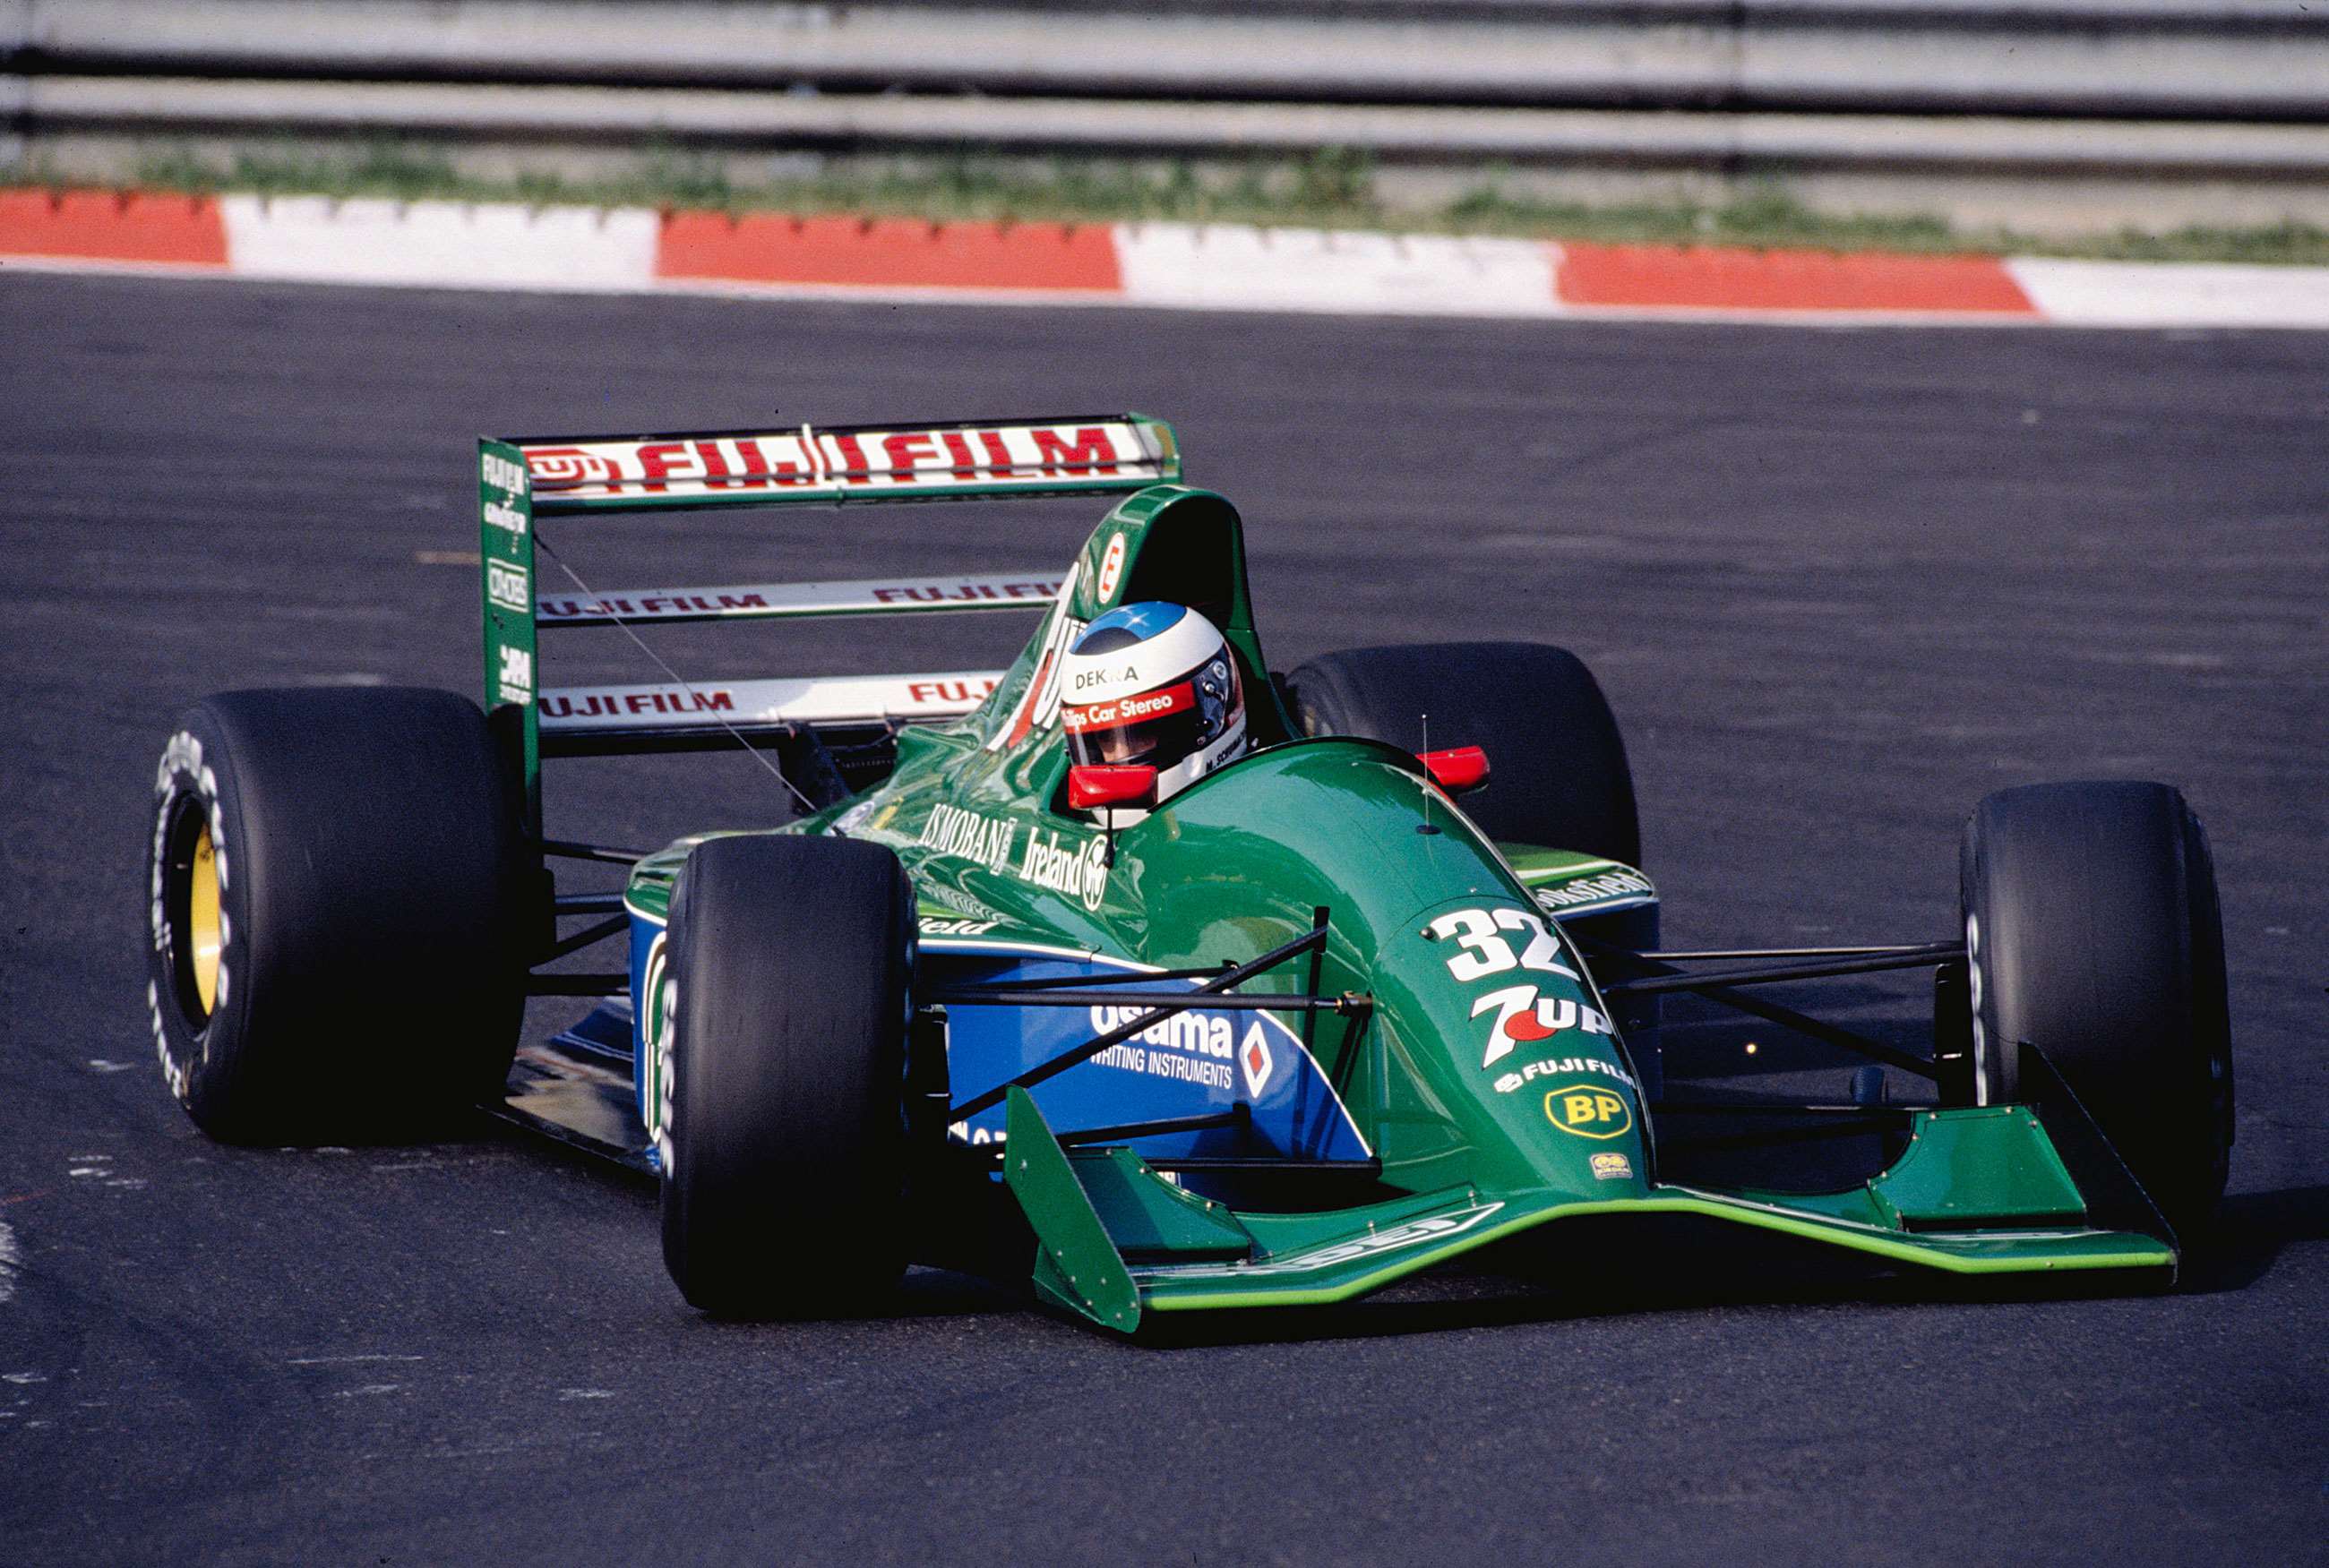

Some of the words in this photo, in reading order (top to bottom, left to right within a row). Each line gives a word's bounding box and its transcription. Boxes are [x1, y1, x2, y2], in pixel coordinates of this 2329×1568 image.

[637, 427, 1119, 493] FUJIFILM
[539, 594, 769, 617] UJIFILM
[1075, 666, 1139, 690] DEKA
[537, 691, 735, 717] UJIFILM
[1088, 705, 1117, 724] Car
[1120, 694, 1173, 717] Stereo
[1019, 827, 1087, 895] Ireland
[1429, 908, 1581, 982] 32
[1090, 1006, 1233, 1059] osama
[1091, 1045, 1145, 1073] WRITING
[1148, 1051, 1233, 1090] INSTRUMENTS
[1563, 1094, 1622, 1126] BP
